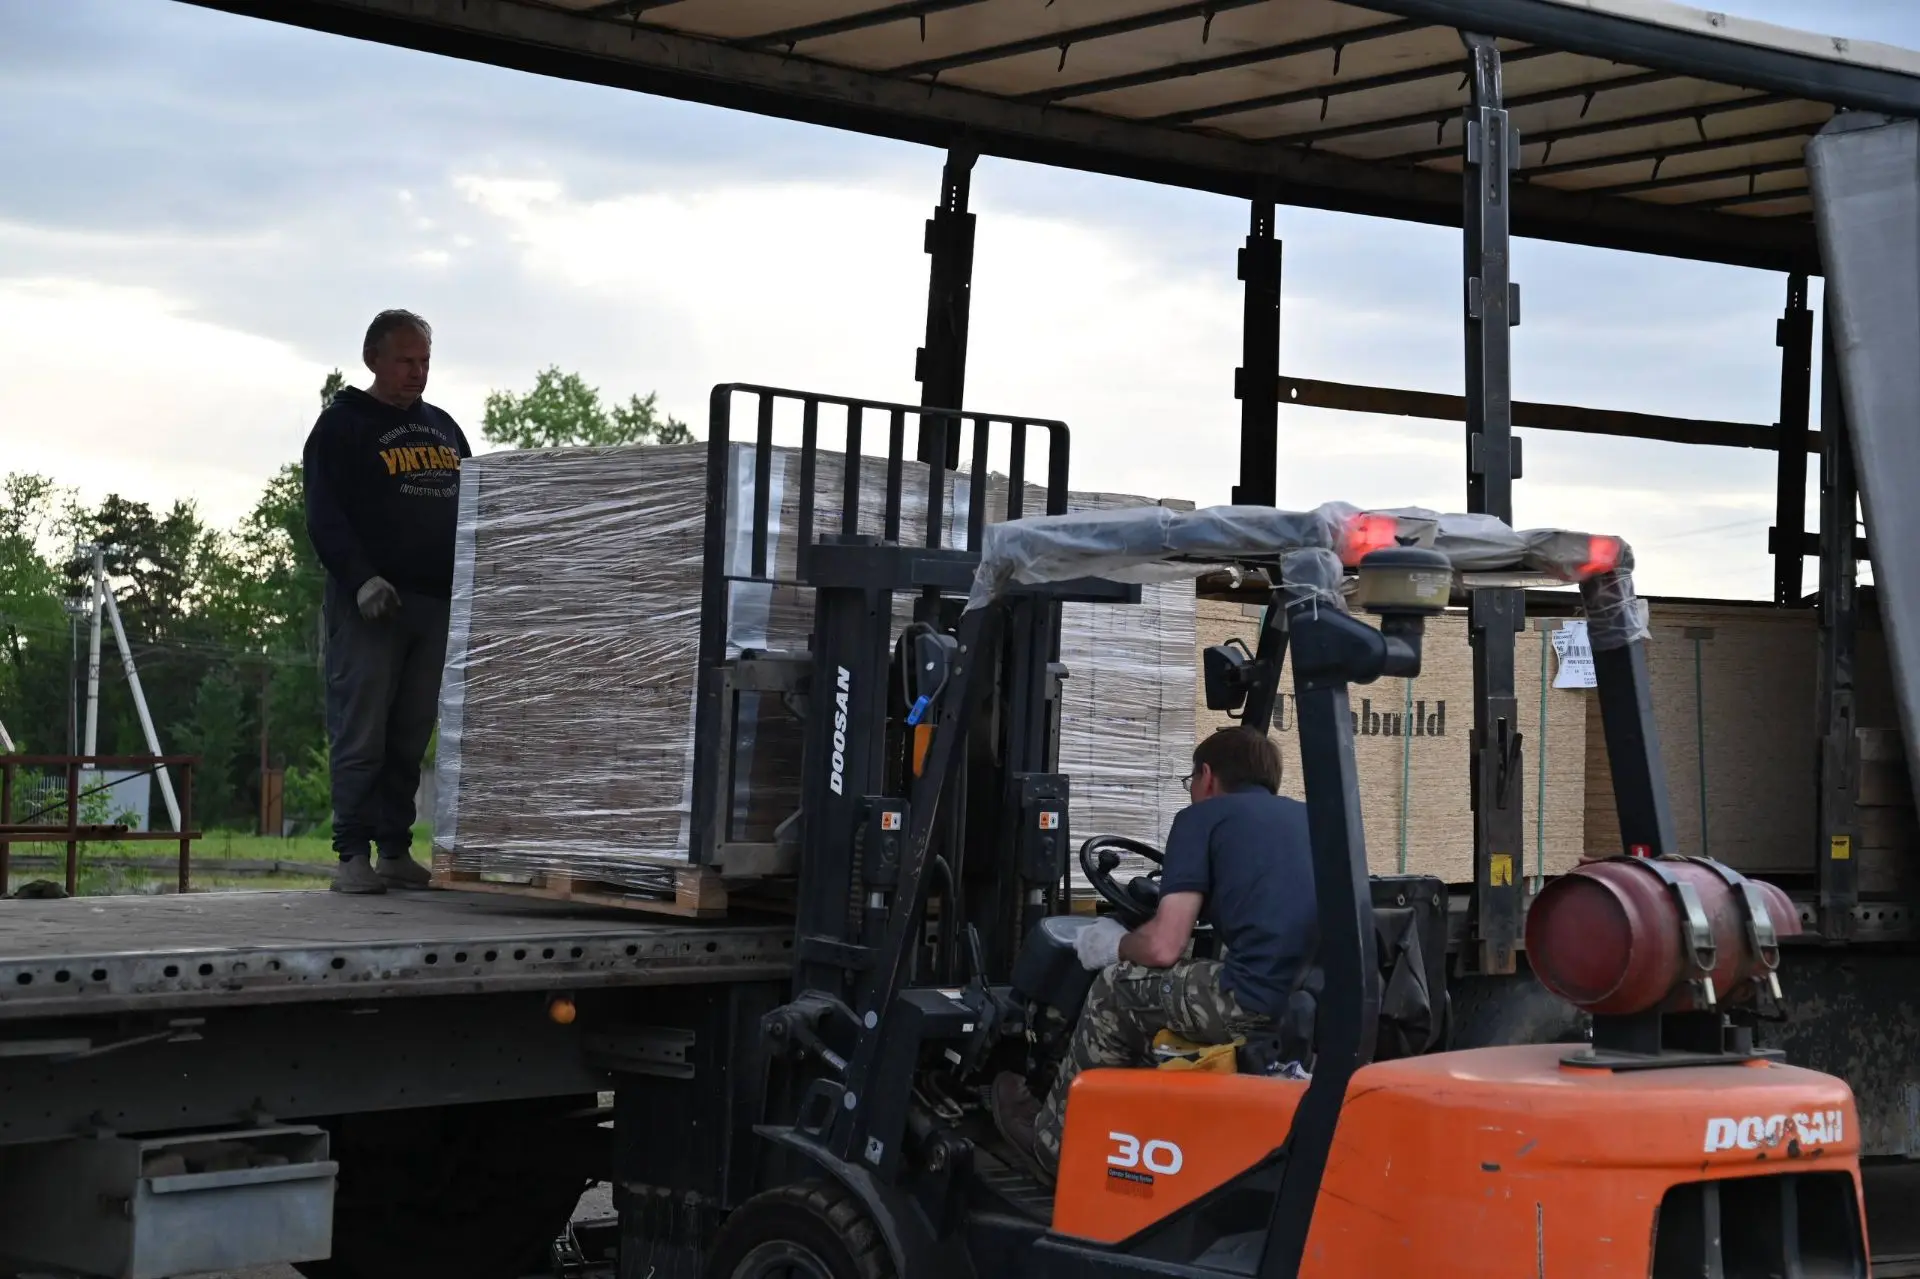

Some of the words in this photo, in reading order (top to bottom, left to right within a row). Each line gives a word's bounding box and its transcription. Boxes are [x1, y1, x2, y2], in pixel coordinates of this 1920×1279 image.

[379, 425, 409, 444] ORIGINAL
[379, 445, 460, 475] VINTAGE
[400, 483, 441, 498] INDUSTRIAL
[830, 665, 851, 796] DOOSAN
[1107, 1131, 1183, 1175] 30
